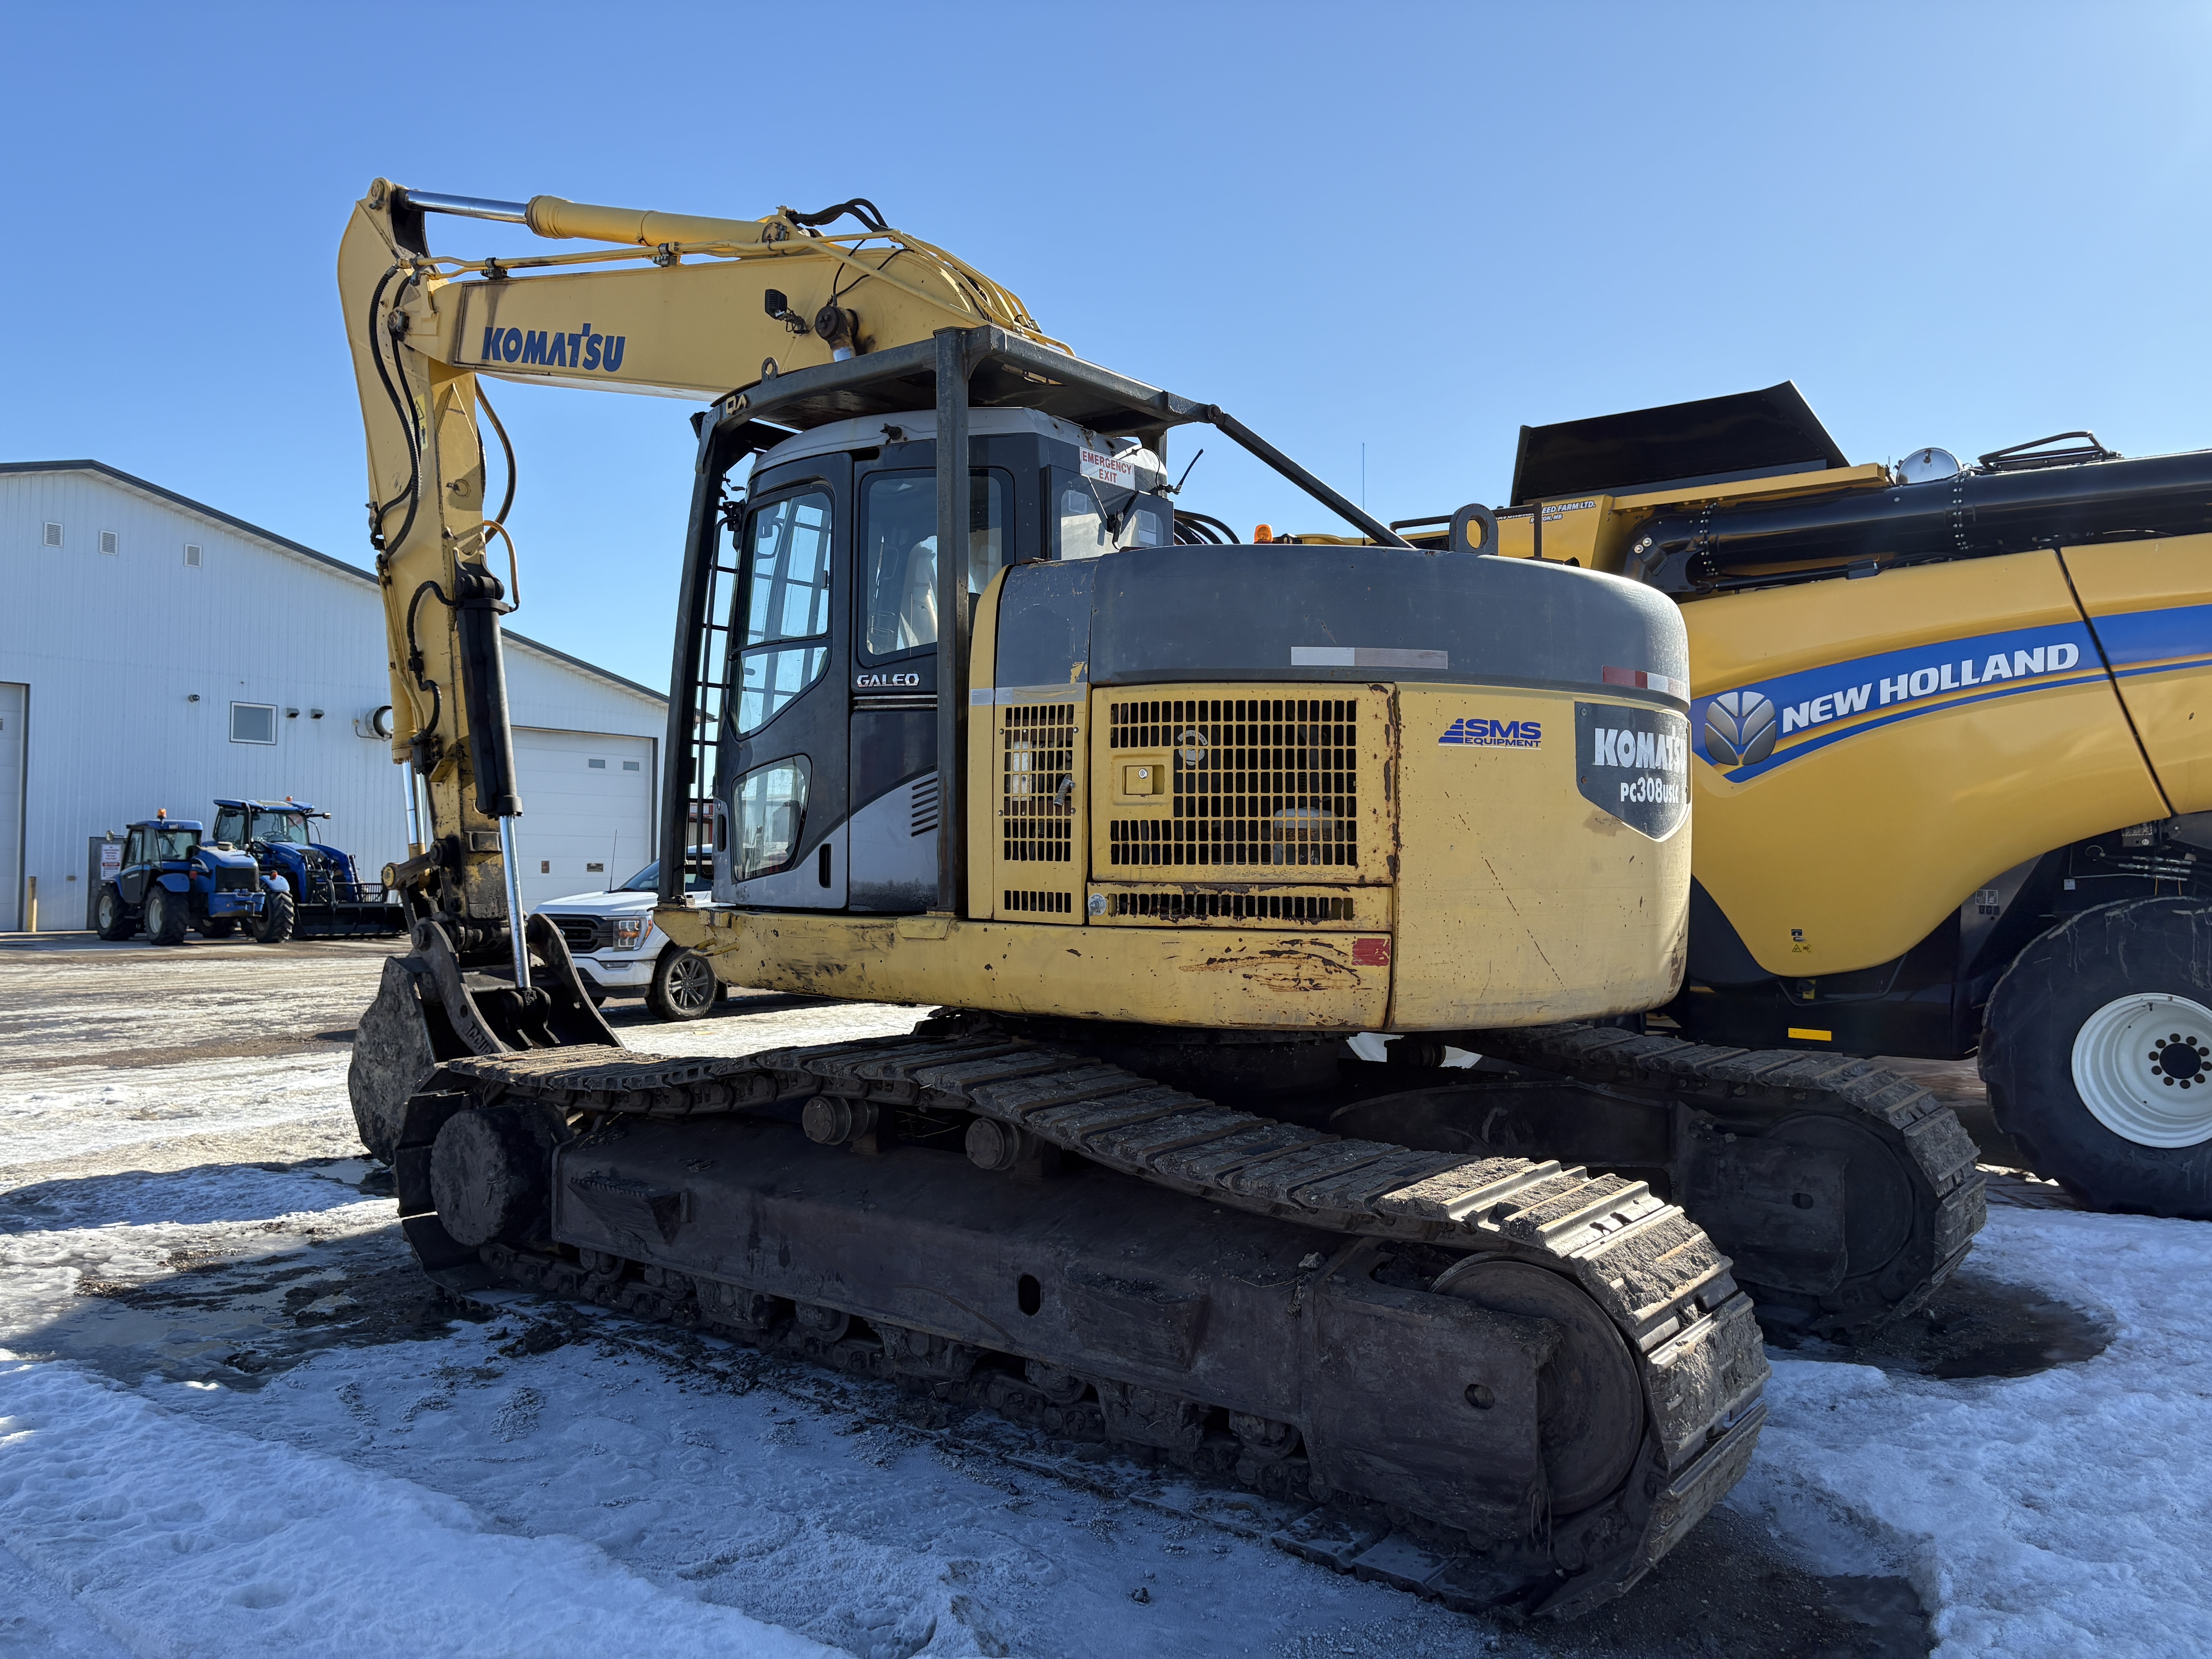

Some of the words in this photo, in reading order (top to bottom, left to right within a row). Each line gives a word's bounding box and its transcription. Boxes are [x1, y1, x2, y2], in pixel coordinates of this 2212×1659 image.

[481, 323, 625, 372] KOMATSU
[1082, 451, 1132, 475] EMERGENCY
[1099, 469, 1117, 483] EXIT
[1557, 502, 1580, 512] FARM
[1580, 500, 1596, 509] LTD.
[857, 673, 920, 688] GALEO
[1782, 683, 1873, 734] NEW
[1879, 642, 2080, 705] HOLLAND
[1465, 718, 1541, 739] SMS
[1465, 737, 1541, 747] EQUIPMENT
[1595, 725, 1686, 775] KOMATSU
[1620, 776, 1679, 804] PC308USLC
